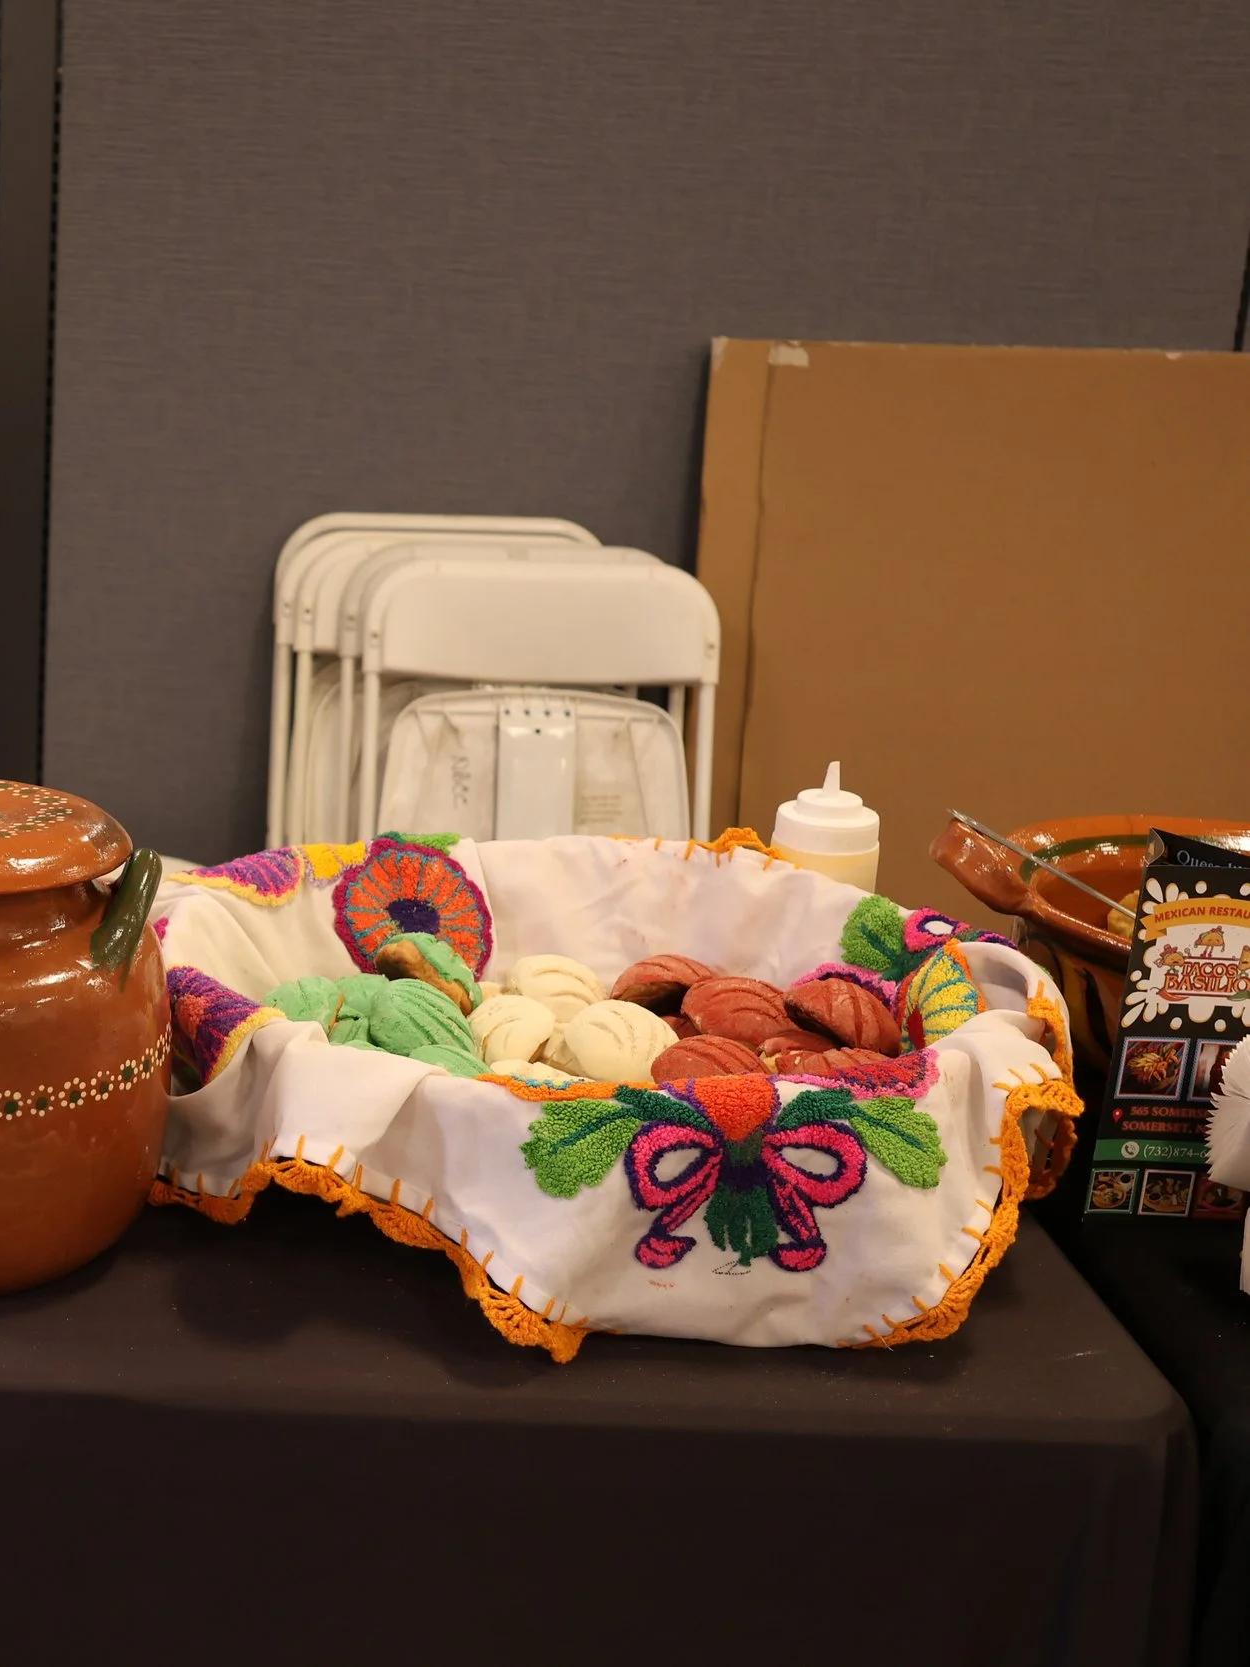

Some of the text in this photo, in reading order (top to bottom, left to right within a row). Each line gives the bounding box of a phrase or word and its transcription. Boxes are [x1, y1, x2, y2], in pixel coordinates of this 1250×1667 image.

[1154, 906, 1250, 924] MEXICAN RESTAU
[1182, 961, 1239, 978] TACOS
[1163, 973, 1250, 993] BASILIO
[1130, 1106, 1149, 1117] 565
